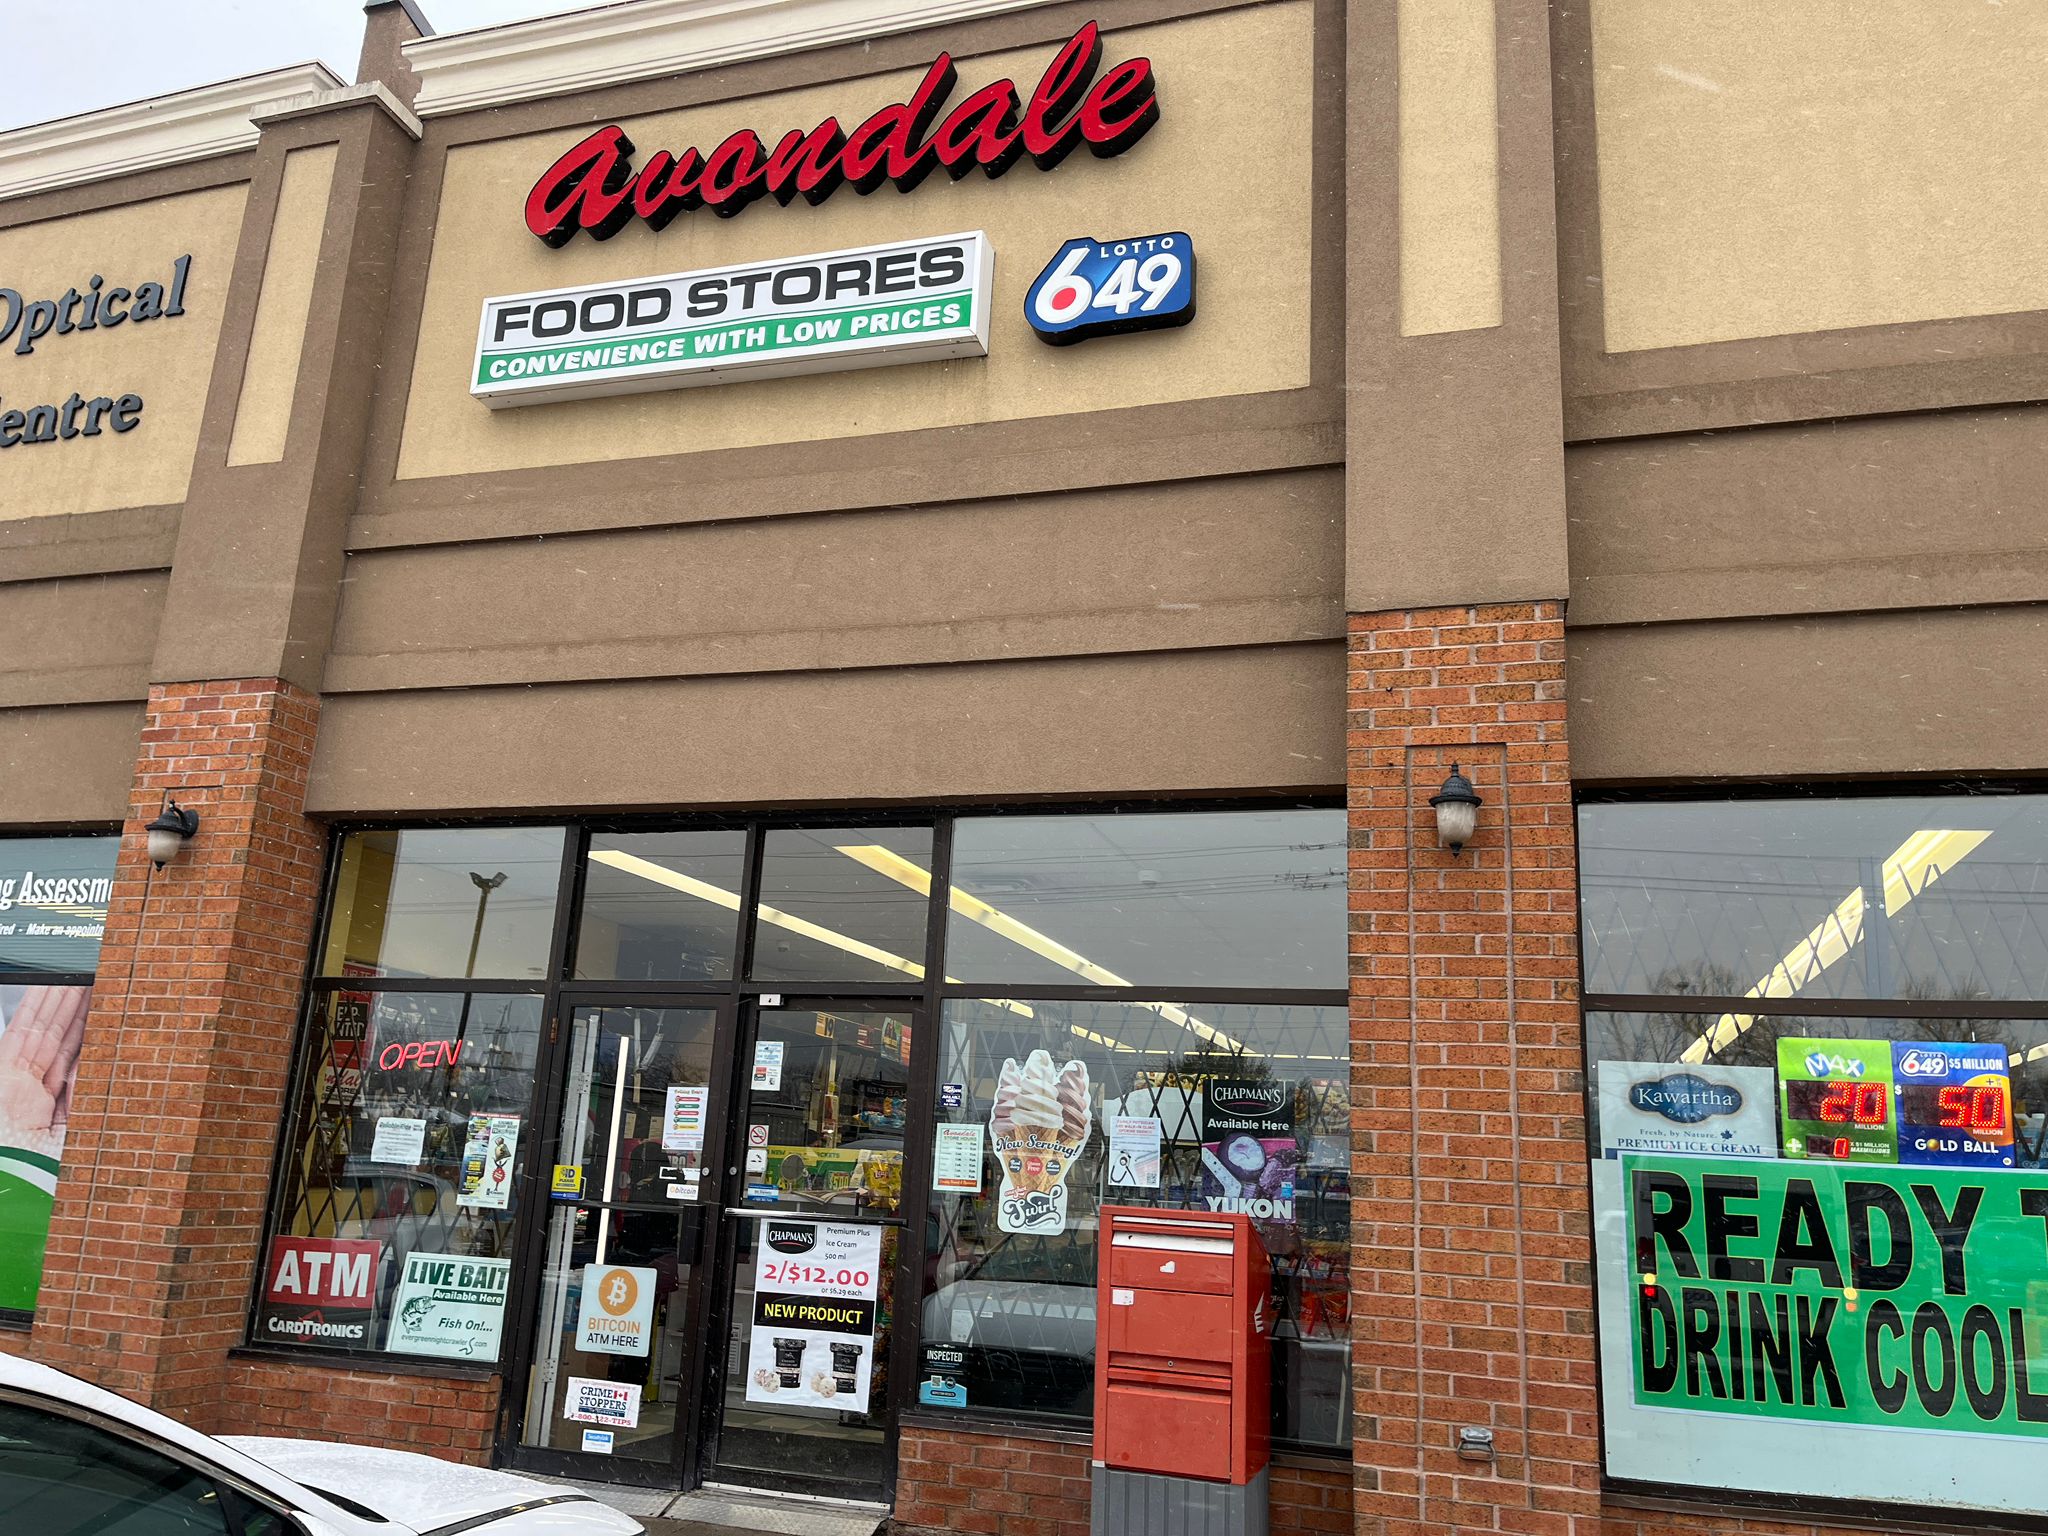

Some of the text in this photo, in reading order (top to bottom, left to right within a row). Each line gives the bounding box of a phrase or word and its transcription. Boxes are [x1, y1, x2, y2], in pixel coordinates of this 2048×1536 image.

[1100, 237, 1175, 259] LOTTO
[493, 246, 965, 343] FOOD STORES
[1034, 246, 1183, 324] 649
[488, 303, 962, 379] CONVENIENCE WITH LOW PRICES
[0, 392, 144, 448] entre
[17, 871, 114, 903] Assessm
[26, 923, 51, 935] Make
[379, 1039, 463, 1071] OPEN
[1804, 1053, 1862, 1078] MAX
[1902, 1052, 2004, 1074] 649 $5 MILLION
[1214, 1086, 1281, 1104] CHAPMAN'S
[1637, 1088, 1733, 1107] Kawartha
[1820, 1080, 1888, 1124] 20
[1894, 1084, 2003, 1128] $ 50
[1207, 1118, 1290, 1131] Available Here
[1669, 1130, 1680, 1138] by
[1683, 1130, 1718, 1139] Nature.
[1972, 1128, 2004, 1136] MILLION
[996, 1134, 1081, 1159] Now Serving!
[1617, 1138, 1761, 1154] PREMIUM ICE CREAM
[1963, 1140, 1999, 1154] BALL
[674, 1186, 697, 1195] bitcoin
[1003, 1184, 1063, 1228] Swirl
[1205, 1196, 1293, 1220] YUKON
[769, 1229, 814, 1245] CHAPMAN'S
[826, 1226, 856, 1236] Premium
[836, 1240, 858, 1248] Cream
[1631, 1169, 1986, 1297] READY
[272, 1250, 372, 1298] ATM
[407, 1261, 510, 1291] LIVE BAIT
[763, 1260, 869, 1287] 2/$12.00
[433, 1289, 503, 1305] Available Here
[438, 1317, 493, 1332] Fish On!...
[764, 1302, 864, 1325] NEW PRODUCT
[268, 1316, 364, 1339] CARDTRONICS
[587, 1317, 641, 1335] BITCOIN
[586, 1332, 639, 1348] ATM HERE
[926, 1350, 963, 1362] INSPECTED
[1638, 1283, 2048, 1424] DRINK COOL
[580, 1386, 614, 1398] CRIME
[578, 1396, 627, 1411] STOPPERS
[570, 1413, 632, 1426] -800-22-TIPS
